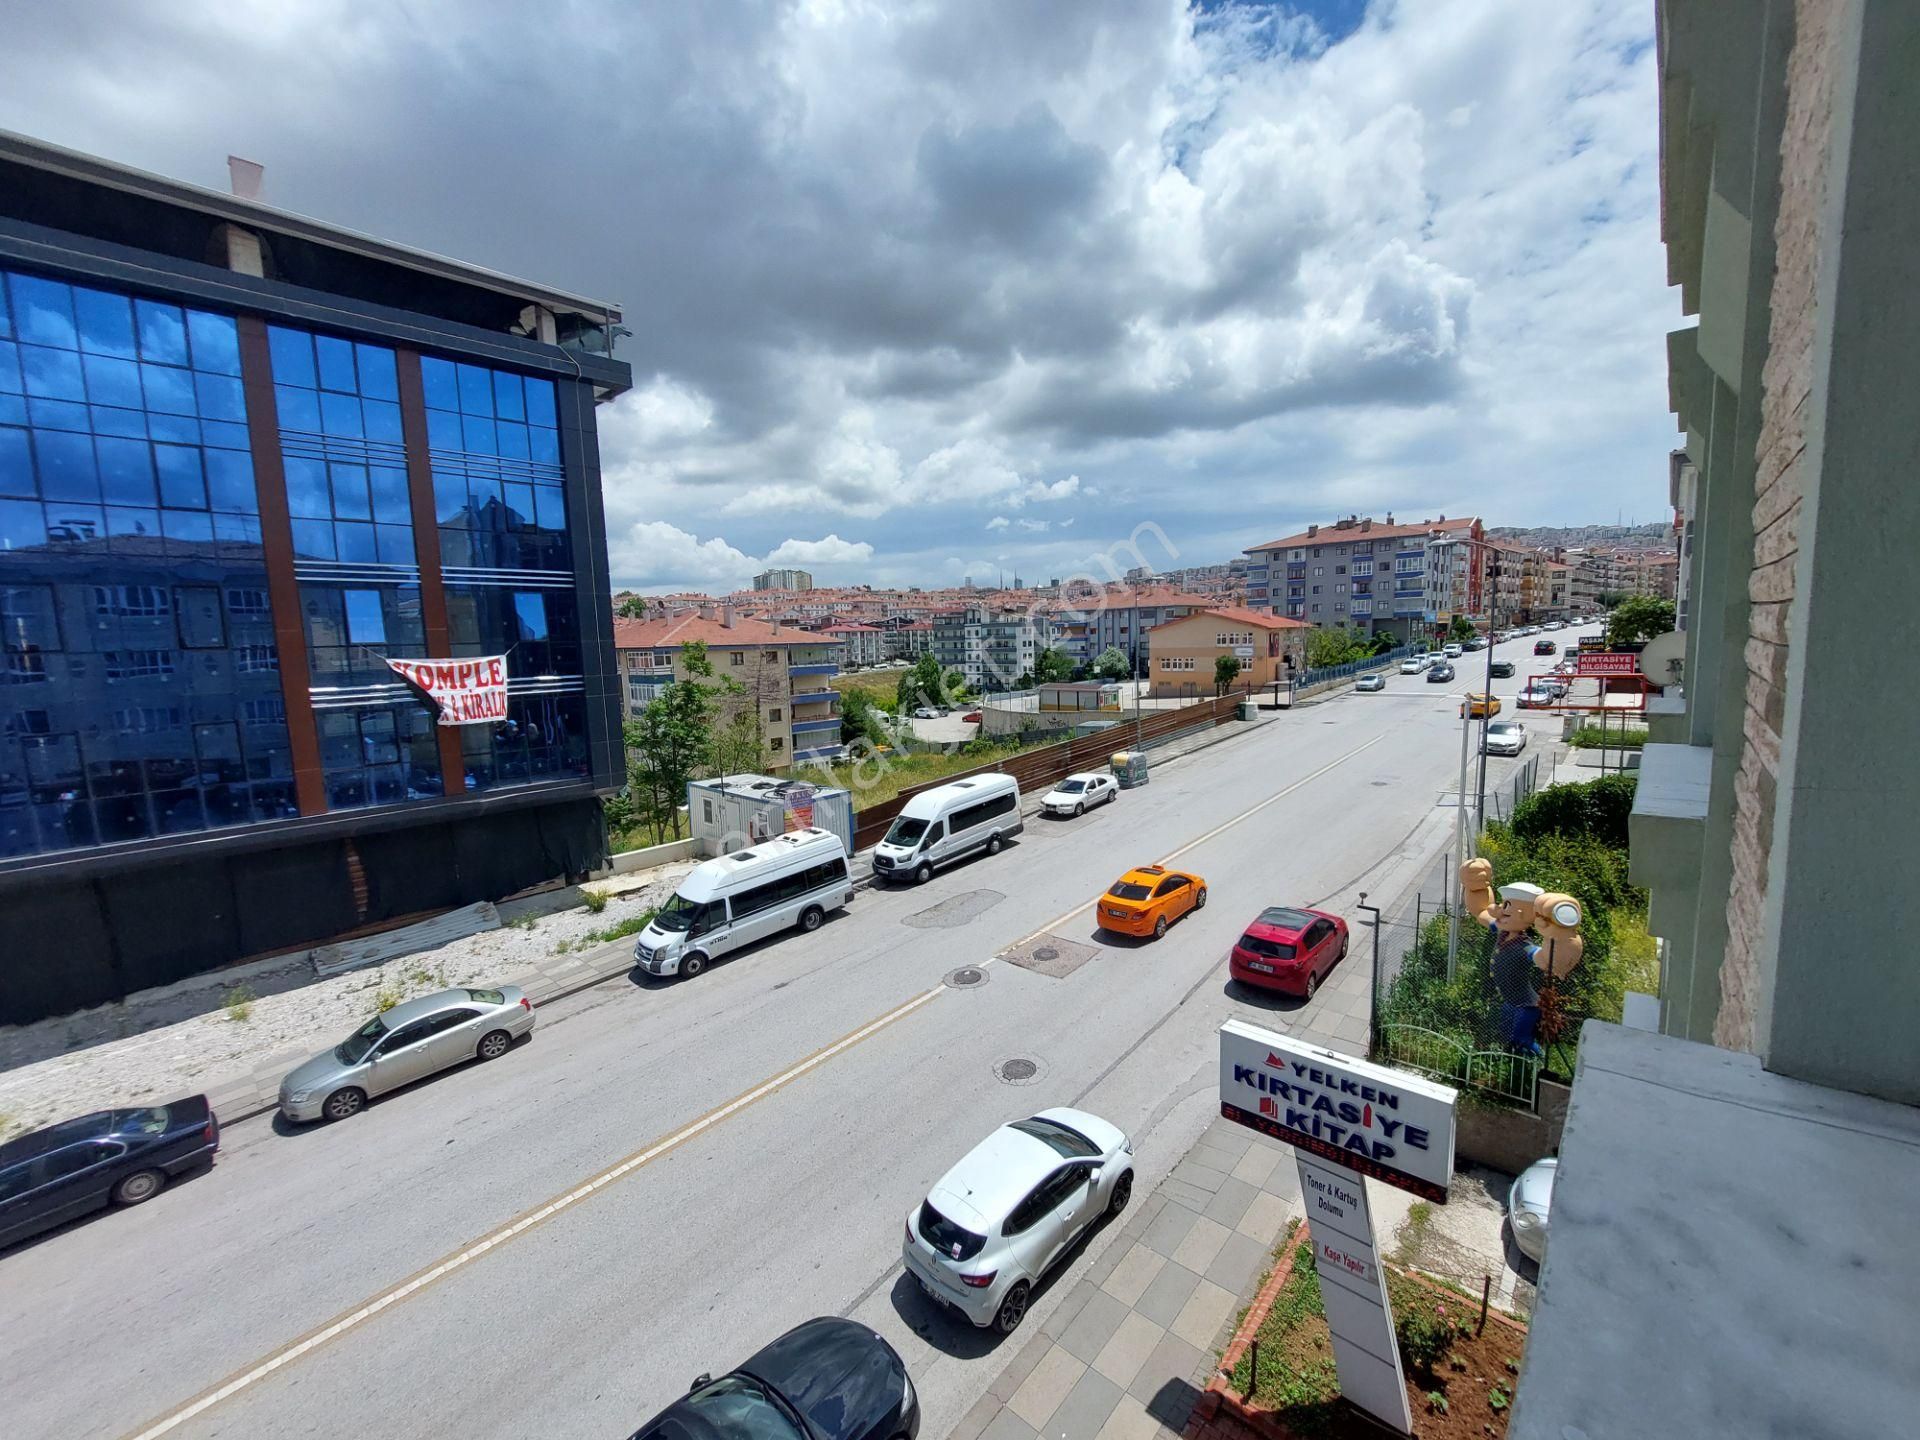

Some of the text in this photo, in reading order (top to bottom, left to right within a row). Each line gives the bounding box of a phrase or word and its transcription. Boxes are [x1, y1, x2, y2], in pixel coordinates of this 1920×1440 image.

[1290, 1061, 1399, 1110] YELKEN
[1286, 1106, 1396, 1160] KİTAP
[1307, 1174, 1358, 1211] Toner & Kartuş
[1318, 1196, 1344, 1218] Dolumu
[1324, 1245, 1341, 1263] Kaşe
